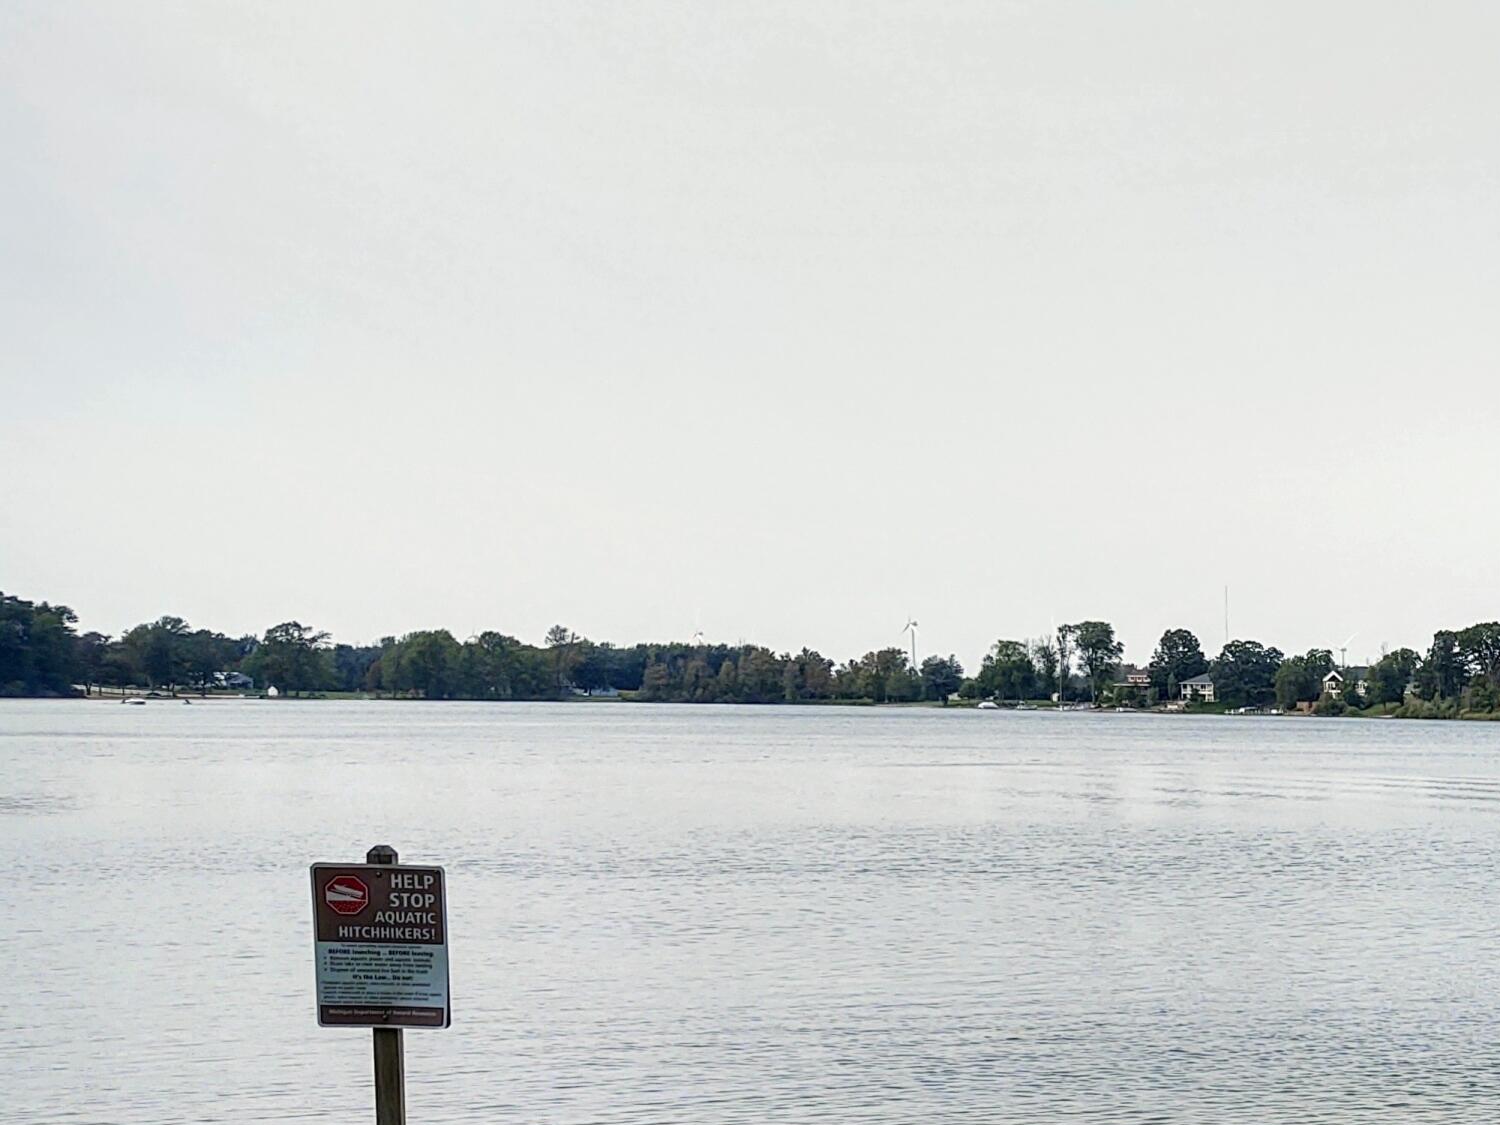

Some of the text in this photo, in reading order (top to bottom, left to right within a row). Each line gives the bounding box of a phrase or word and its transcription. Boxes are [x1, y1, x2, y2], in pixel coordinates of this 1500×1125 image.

[391, 873, 435, 889] HELP
[389, 892, 435, 908] STOP
[374, 911, 437, 925] AQUATIC
[338, 925, 436, 940] HITCHHIKERS!
